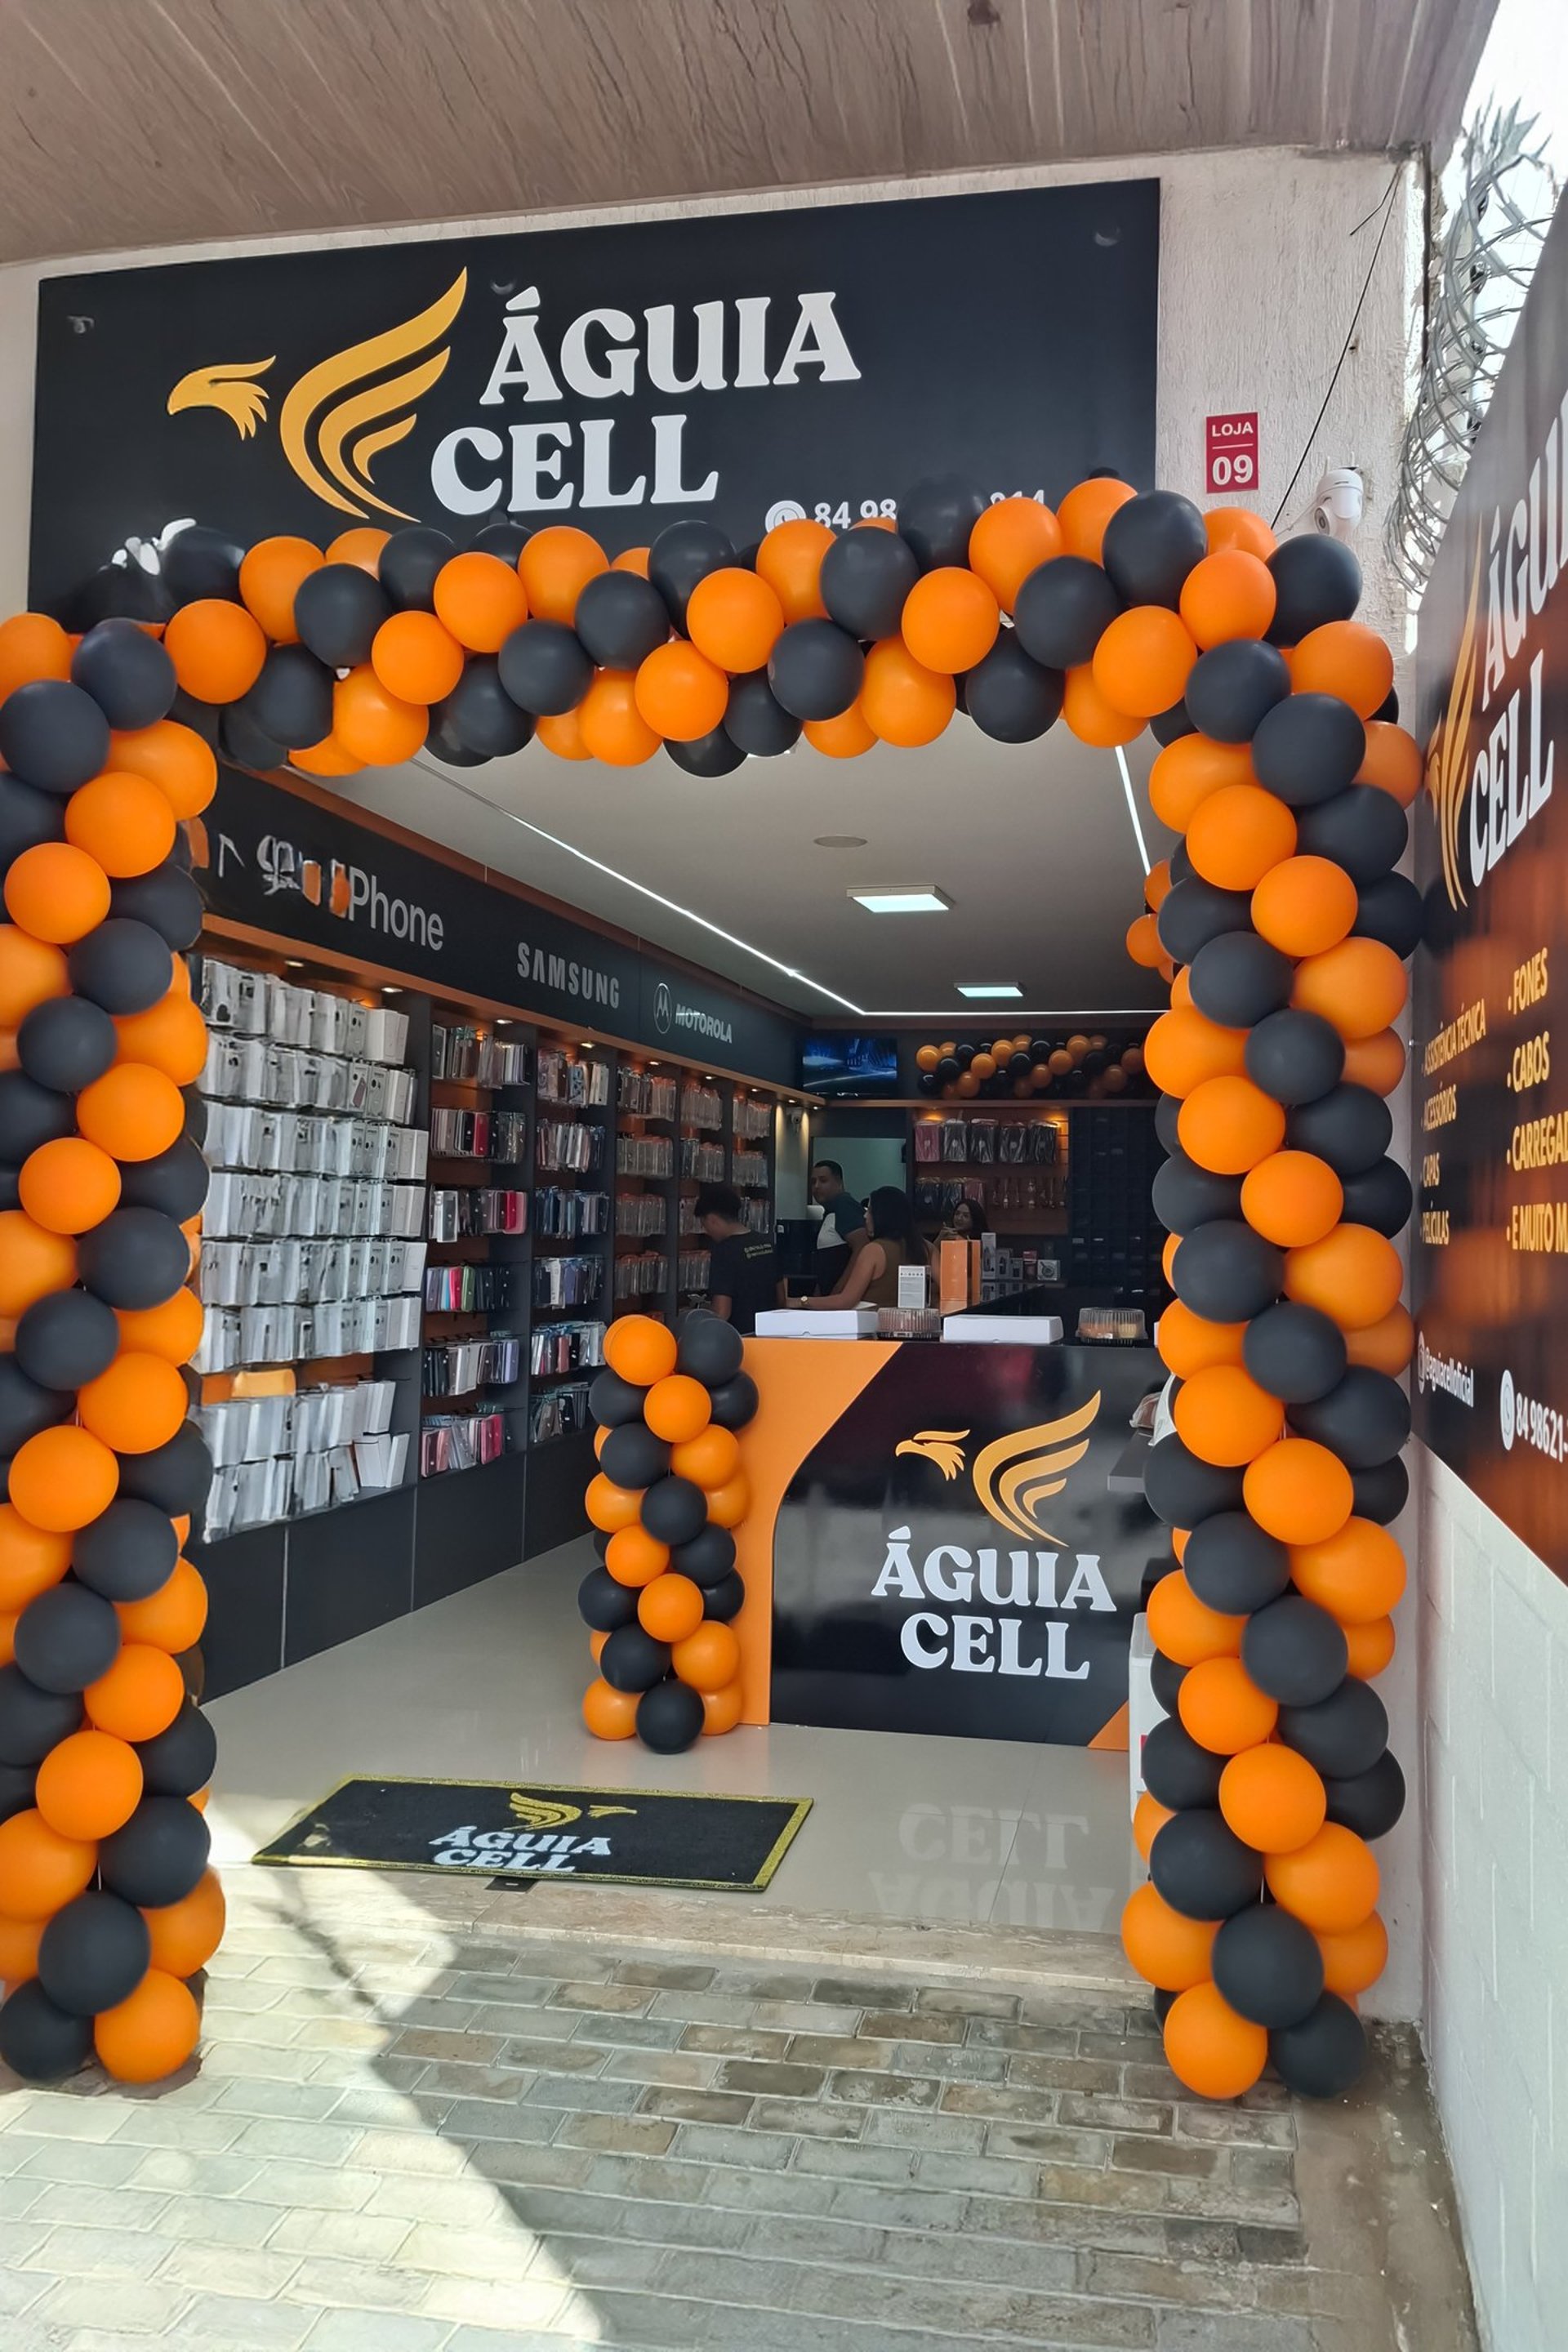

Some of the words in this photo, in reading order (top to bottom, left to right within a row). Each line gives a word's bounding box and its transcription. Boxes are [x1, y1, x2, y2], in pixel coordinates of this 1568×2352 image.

[479, 285, 862, 405] ÁGUIA
[1211, 421, 1254, 438] LOJA
[430, 414, 719, 515] CELL
[1212, 454, 1254, 486] 09
[814, 501, 851, 529] 84
[1470, 648, 1554, 887] CELL
[517, 941, 620, 1009] SAMSUNG
[1513, 947, 1548, 1015] FONES
[675, 1003, 733, 1045] MOTOROLA
[1512, 1030, 1550, 1093] CABOS
[1423, 1152, 1440, 1187] CAPAS
[1512, 1205, 1518, 1250] E
[1519, 1202, 1554, 1253] MUITO
[1516, 1392, 1529, 1441] 84
[871, 1525, 1117, 1612] ÁGUIA
[900, 1612, 1090, 1680] CELL
[428, 1825, 612, 1855] ÁGUIA
[434, 1848, 576, 1873] CELL
